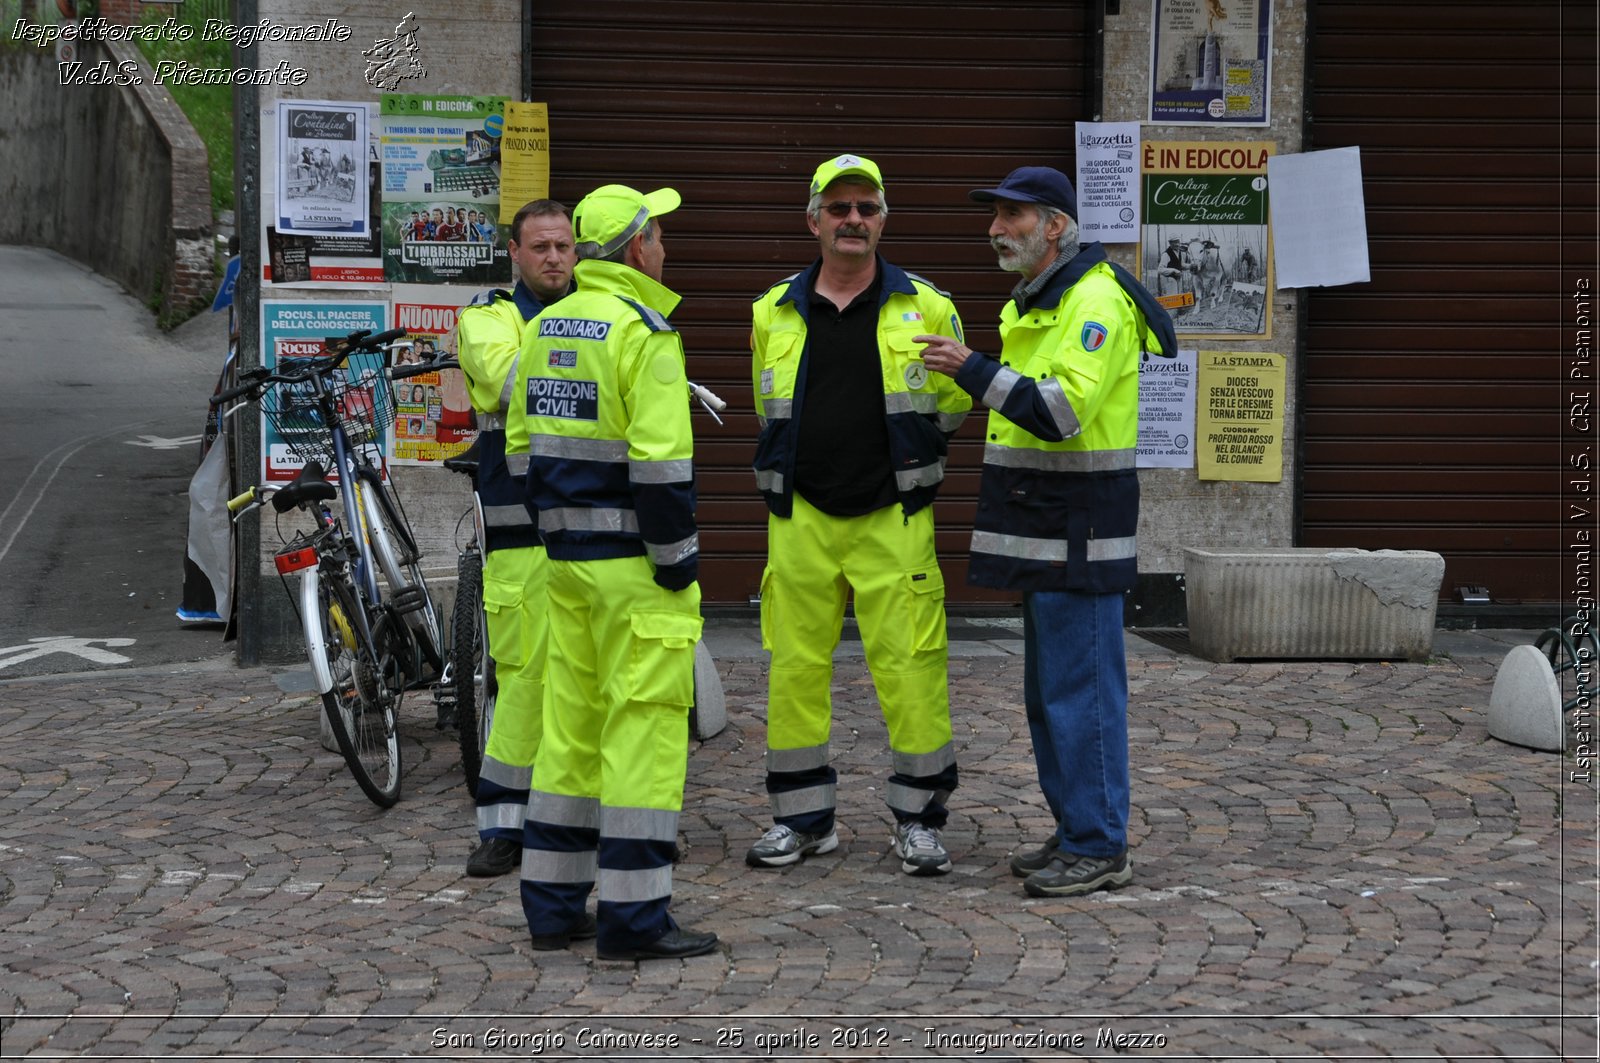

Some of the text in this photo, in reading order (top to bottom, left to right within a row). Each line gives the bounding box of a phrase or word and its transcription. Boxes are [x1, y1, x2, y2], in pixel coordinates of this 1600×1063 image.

[423, 101, 473, 112] IN EDICOLA
[294, 113, 348, 131] Contadina
[389, 126, 417, 134] TIMBRINI
[418, 127, 435, 135] SONO
[505, 137, 526, 151] PRANZO
[1144, 144, 1269, 169] È IN EDICOLA
[1154, 178, 1252, 207] Contadina
[1174, 206, 1246, 221] in Piemonte
[388, 248, 401, 256] 2011
[494, 249, 508, 257] 2012
[420, 257, 477, 267] CAMPIONATO
[278, 311, 371, 320] FOCUS. IL PIACERE
[399, 307, 455, 331] NUOVO
[272, 320, 378, 330] DELLA CONOSCENZA
[540, 319, 608, 339] VOLONTARIO
[276, 342, 320, 355] Focus
[1213, 356, 1274, 367] LA STAMPA
[1226, 376, 1259, 388] DIOCESI
[528, 379, 597, 400] PROTEZIONE
[1210, 387, 1274, 399] SENZA VESCOVO
[536, 398, 577, 418] CIVILE
[1209, 398, 1273, 409] PER LE CRESIME
[1209, 408, 1273, 420] TORNA BETTAZZI
[1208, 433, 1274, 445] PROFONDO ROSSO
[1165, 448, 1188, 456] edicola
[1215, 444, 1266, 455] NEL BILANCIO
[1216, 454, 1264, 465] DEL COMUNE
